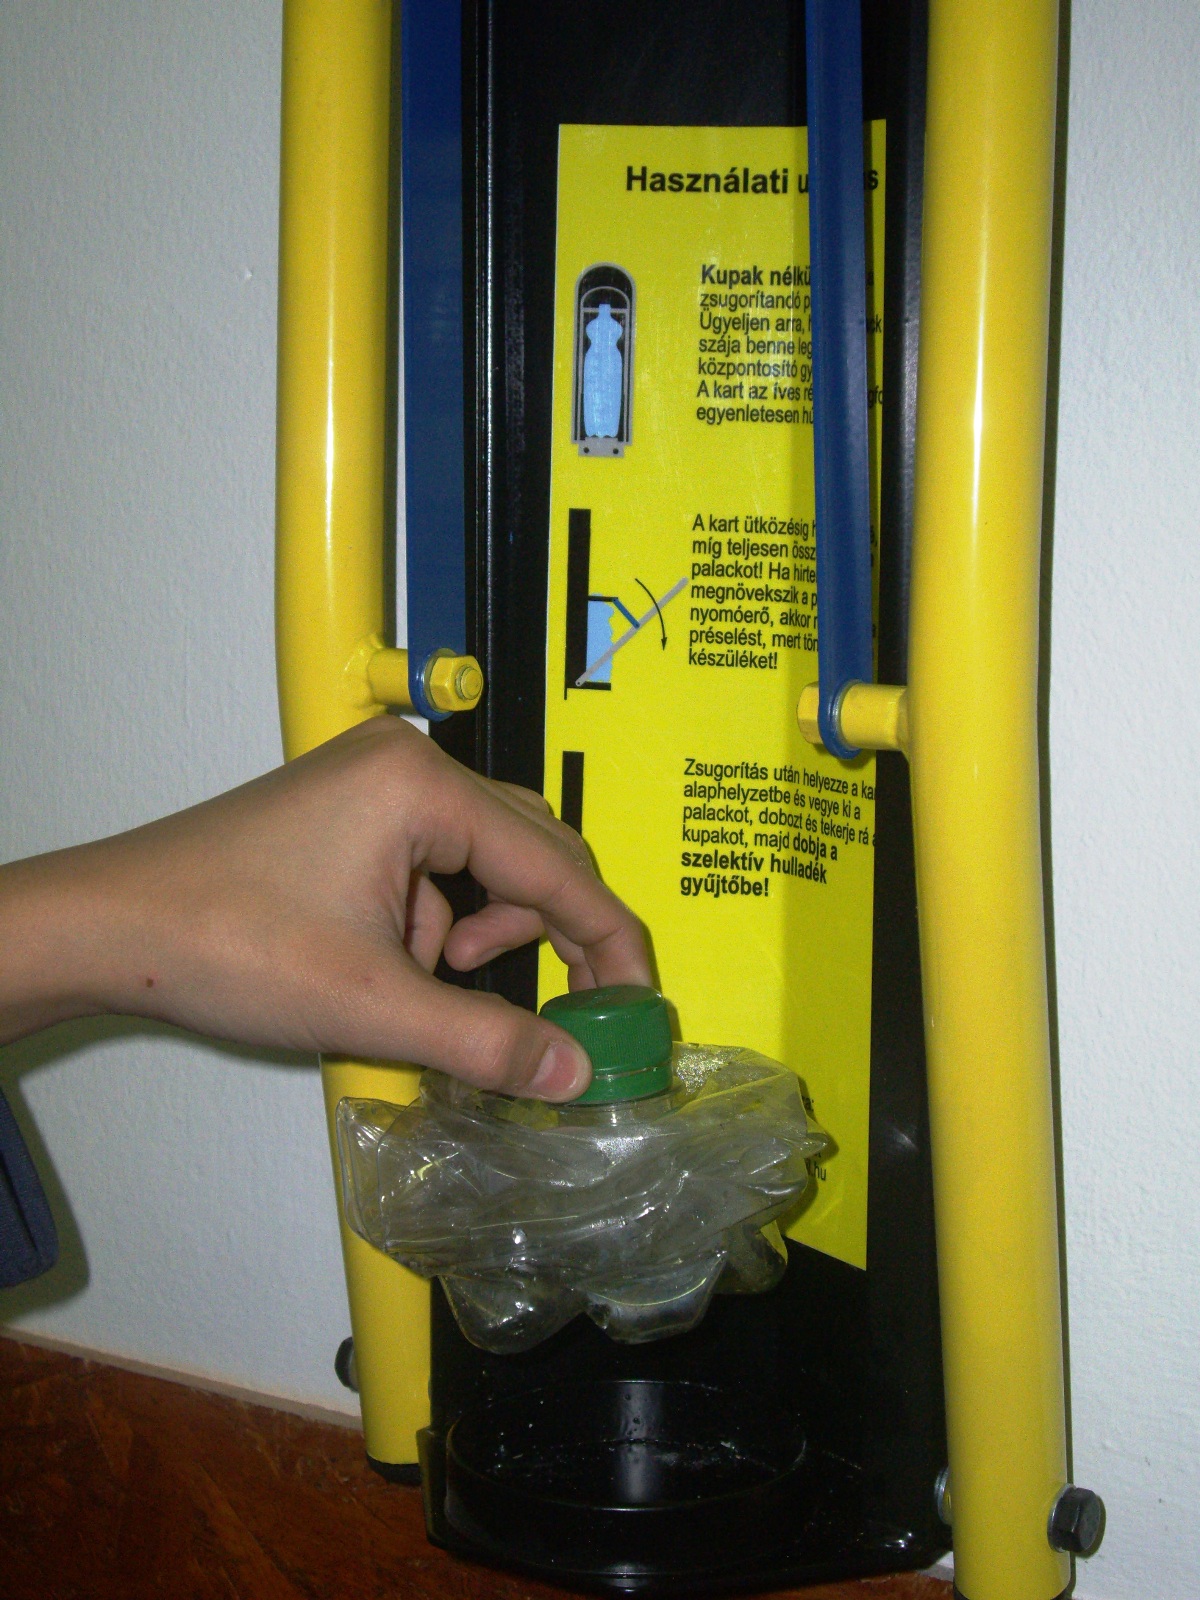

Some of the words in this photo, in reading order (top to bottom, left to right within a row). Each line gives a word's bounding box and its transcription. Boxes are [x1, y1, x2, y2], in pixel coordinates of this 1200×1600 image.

[626, 166, 788, 193] Használati
[701, 264, 763, 289] Kupak
[770, 266, 810, 286] nélkü
[700, 290, 800, 311] zsugorítandó
[701, 308, 769, 335] Ügyeljen
[775, 316, 804, 334] arra,
[699, 335, 740, 357] szája
[747, 336, 794, 354] benne
[698, 358, 797, 379] központosító
[697, 380, 709, 397] A
[714, 381, 744, 399] kart
[749, 385, 767, 399] az
[773, 382, 800, 401] íves
[697, 404, 799, 425] egyenletesen
[693, 514, 705, 531] A
[709, 515, 739, 533] kart
[744, 516, 808, 541] ütközésig
[693, 537, 722, 558] míg
[728, 539, 788, 560] teljesen
[691, 560, 763, 580] palackot!
[769, 563, 789, 580] Ha
[794, 563, 817, 583] hirte
[691, 583, 798, 604] megnövekszik
[802, 594, 808, 605] a
[691, 606, 774, 627] nyomóerő,
[780, 609, 811, 628] akkor
[689, 627, 766, 649] préselést,
[772, 633, 801, 649] mert
[689, 648, 777, 669] készüléket!
[684, 758, 768, 781] Zsugorítás
[774, 765, 799, 784] után
[804, 768, 848, 794] helyezze
[852, 785, 857, 796] a
[862, 781, 875, 800] ka
[684, 781, 790, 805] alaphelyzetbe
[794, 792, 805, 807] és
[809, 796, 839, 817] vegye
[843, 799, 851, 818] ki
[854, 807, 860, 820] a
[683, 803, 753, 826] palackot,
[759, 807, 802, 829] dobozt
[806, 816, 817, 832] és
[821, 820, 855, 845] tekerje
[859, 828, 869, 845] rá
[683, 824, 748, 848] kupakot,
[754, 831, 789, 852] majd
[794, 836, 826, 861] dobja
[831, 846, 837, 860] a
[681, 850, 764, 871] szelektív
[771, 853, 827, 884] hulladék
[681, 873, 769, 898] gyűjtőbe!
